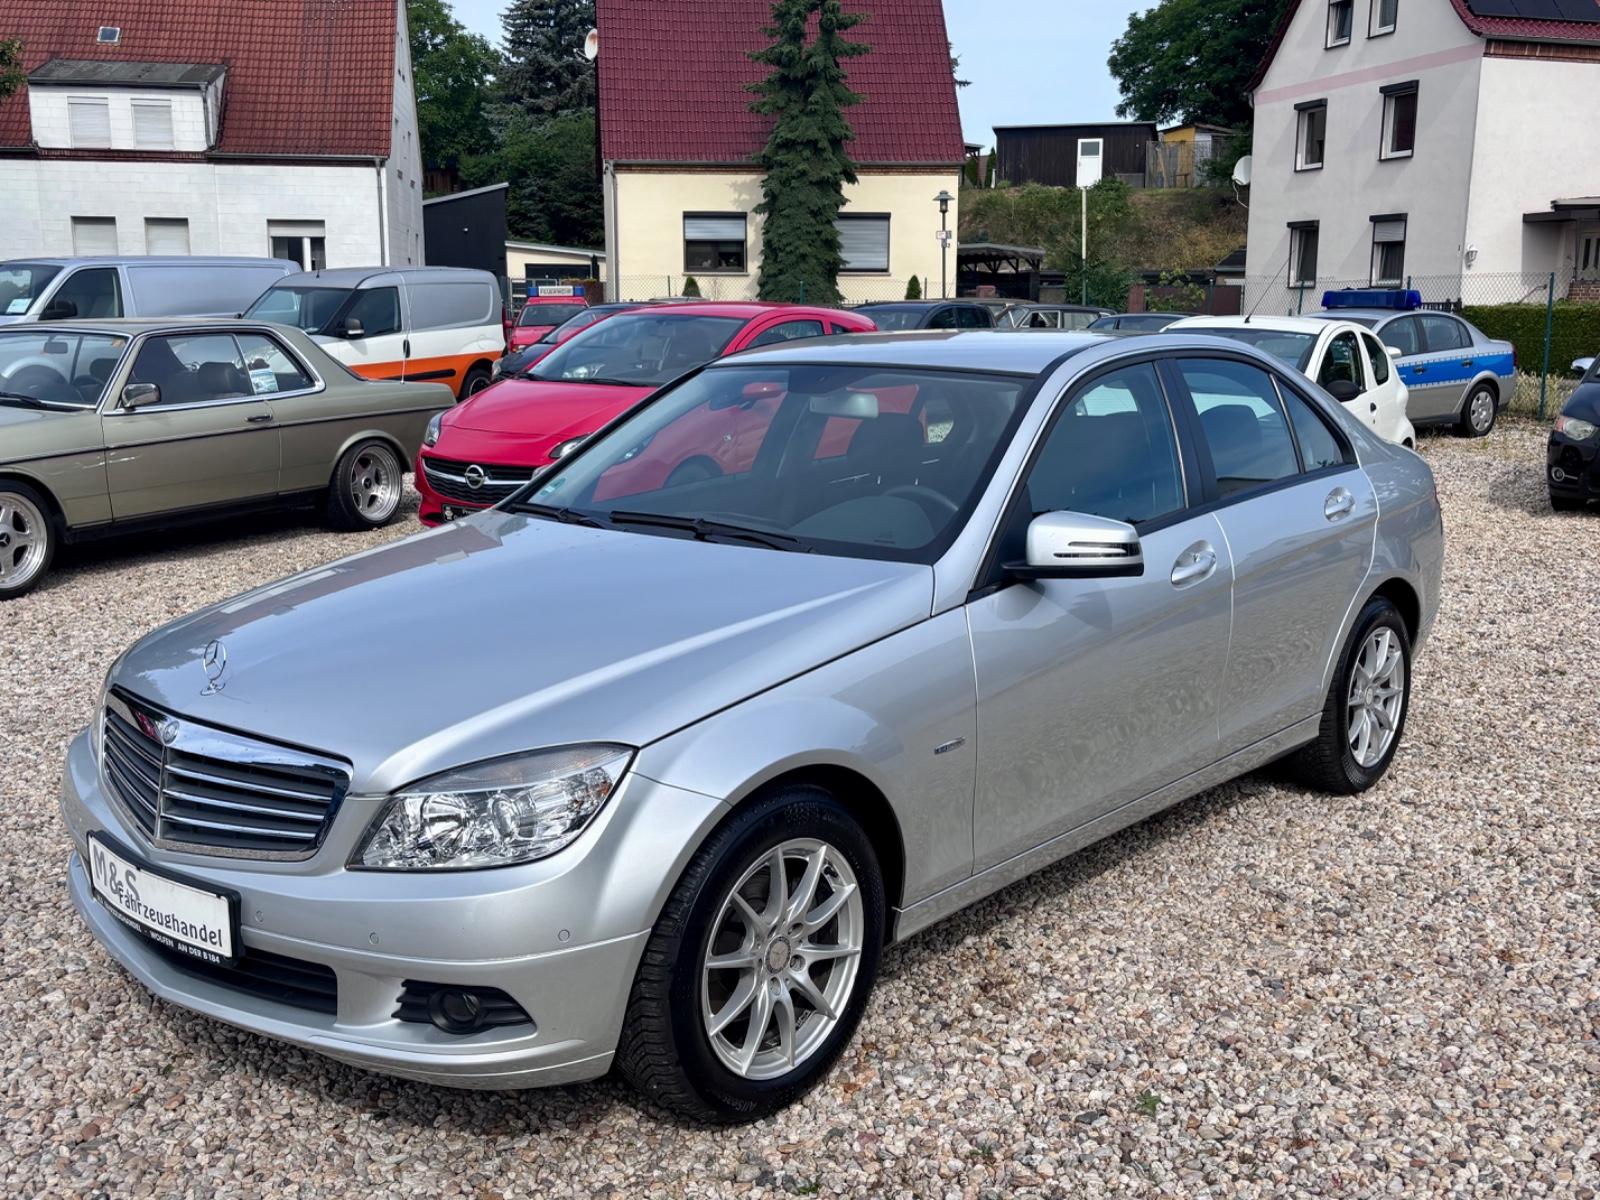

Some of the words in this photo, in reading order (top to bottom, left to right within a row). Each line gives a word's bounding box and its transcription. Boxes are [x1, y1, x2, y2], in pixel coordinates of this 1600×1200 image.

[119, 889, 223, 948] Fahrzeughandel
[177, 942, 188, 953] AN
[189, 946, 202, 959] DER
